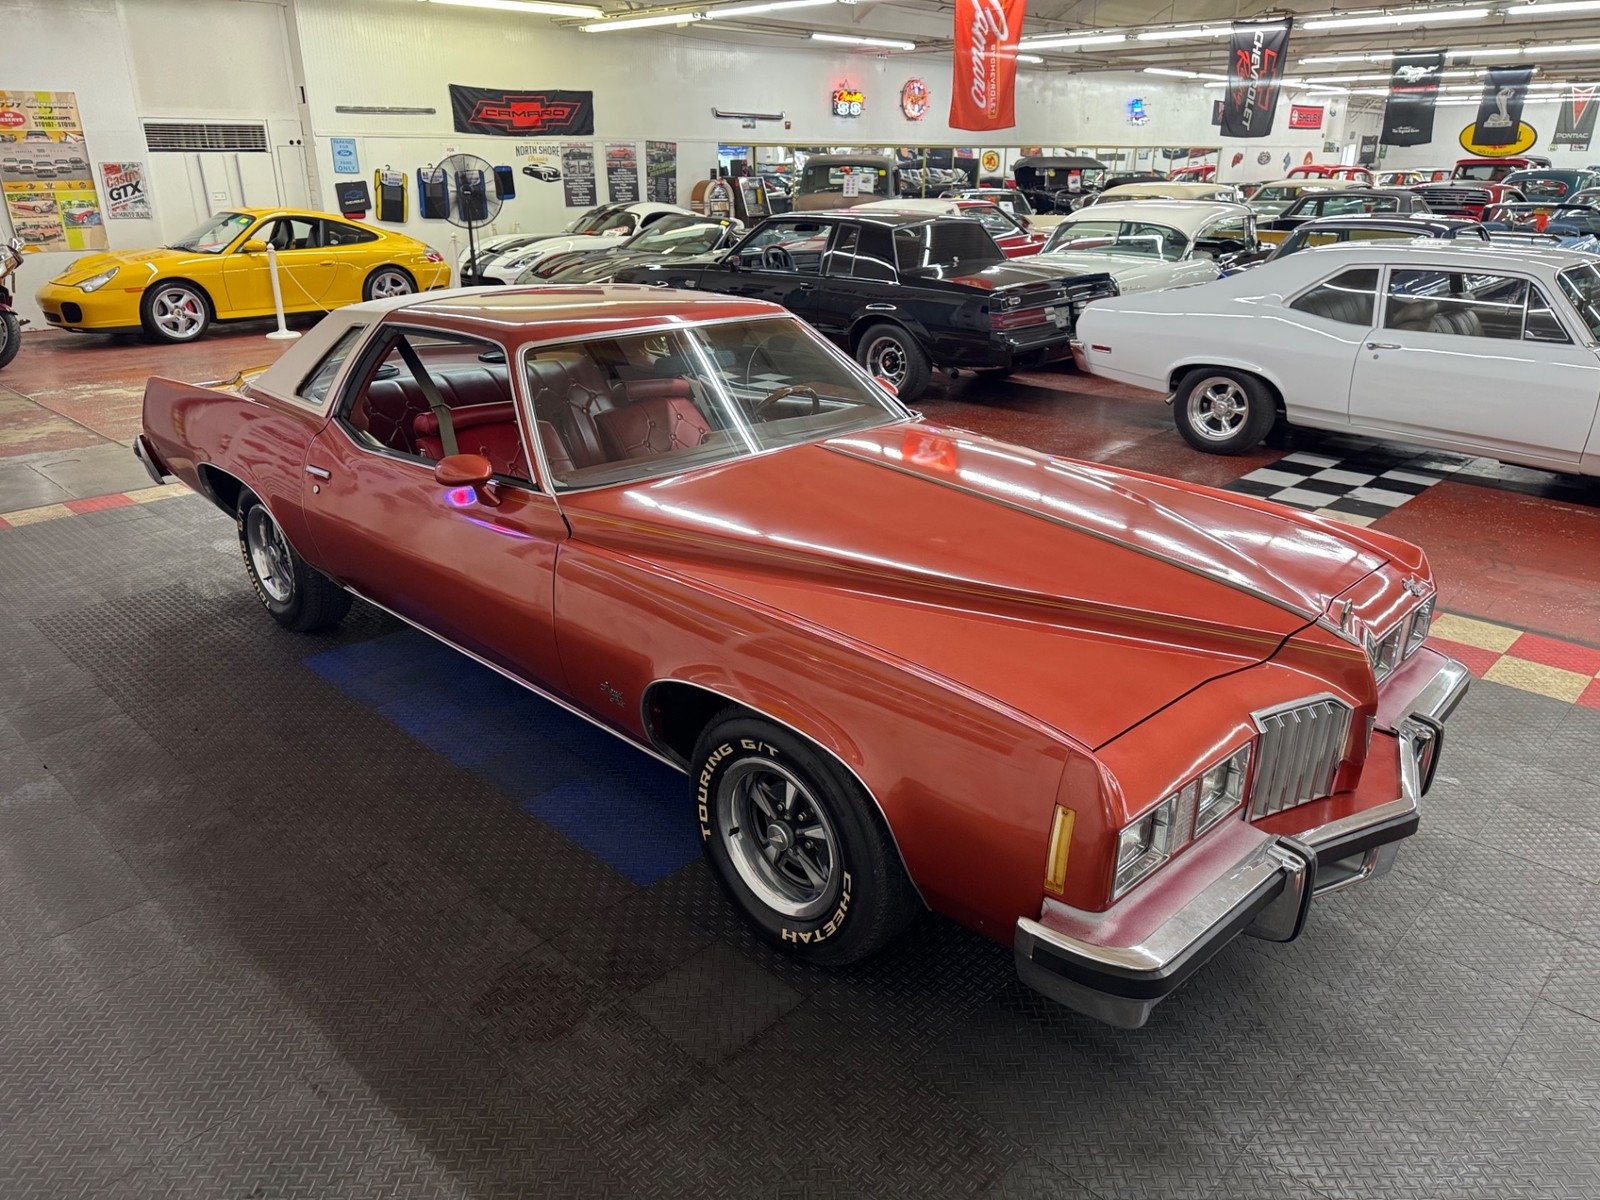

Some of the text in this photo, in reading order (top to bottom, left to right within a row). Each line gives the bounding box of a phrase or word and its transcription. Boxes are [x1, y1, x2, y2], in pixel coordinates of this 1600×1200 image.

[1242, 31, 1264, 131] CHEVROLET
[485, 109, 565, 117] CAMARO
[837, 101, 861, 115] SS
[515, 145, 560, 157] NORTH SHORE
[109, 180, 142, 201] GTX
[697, 739, 779, 841] TOURING G/T
[781, 871, 852, 944] CHEETAH
